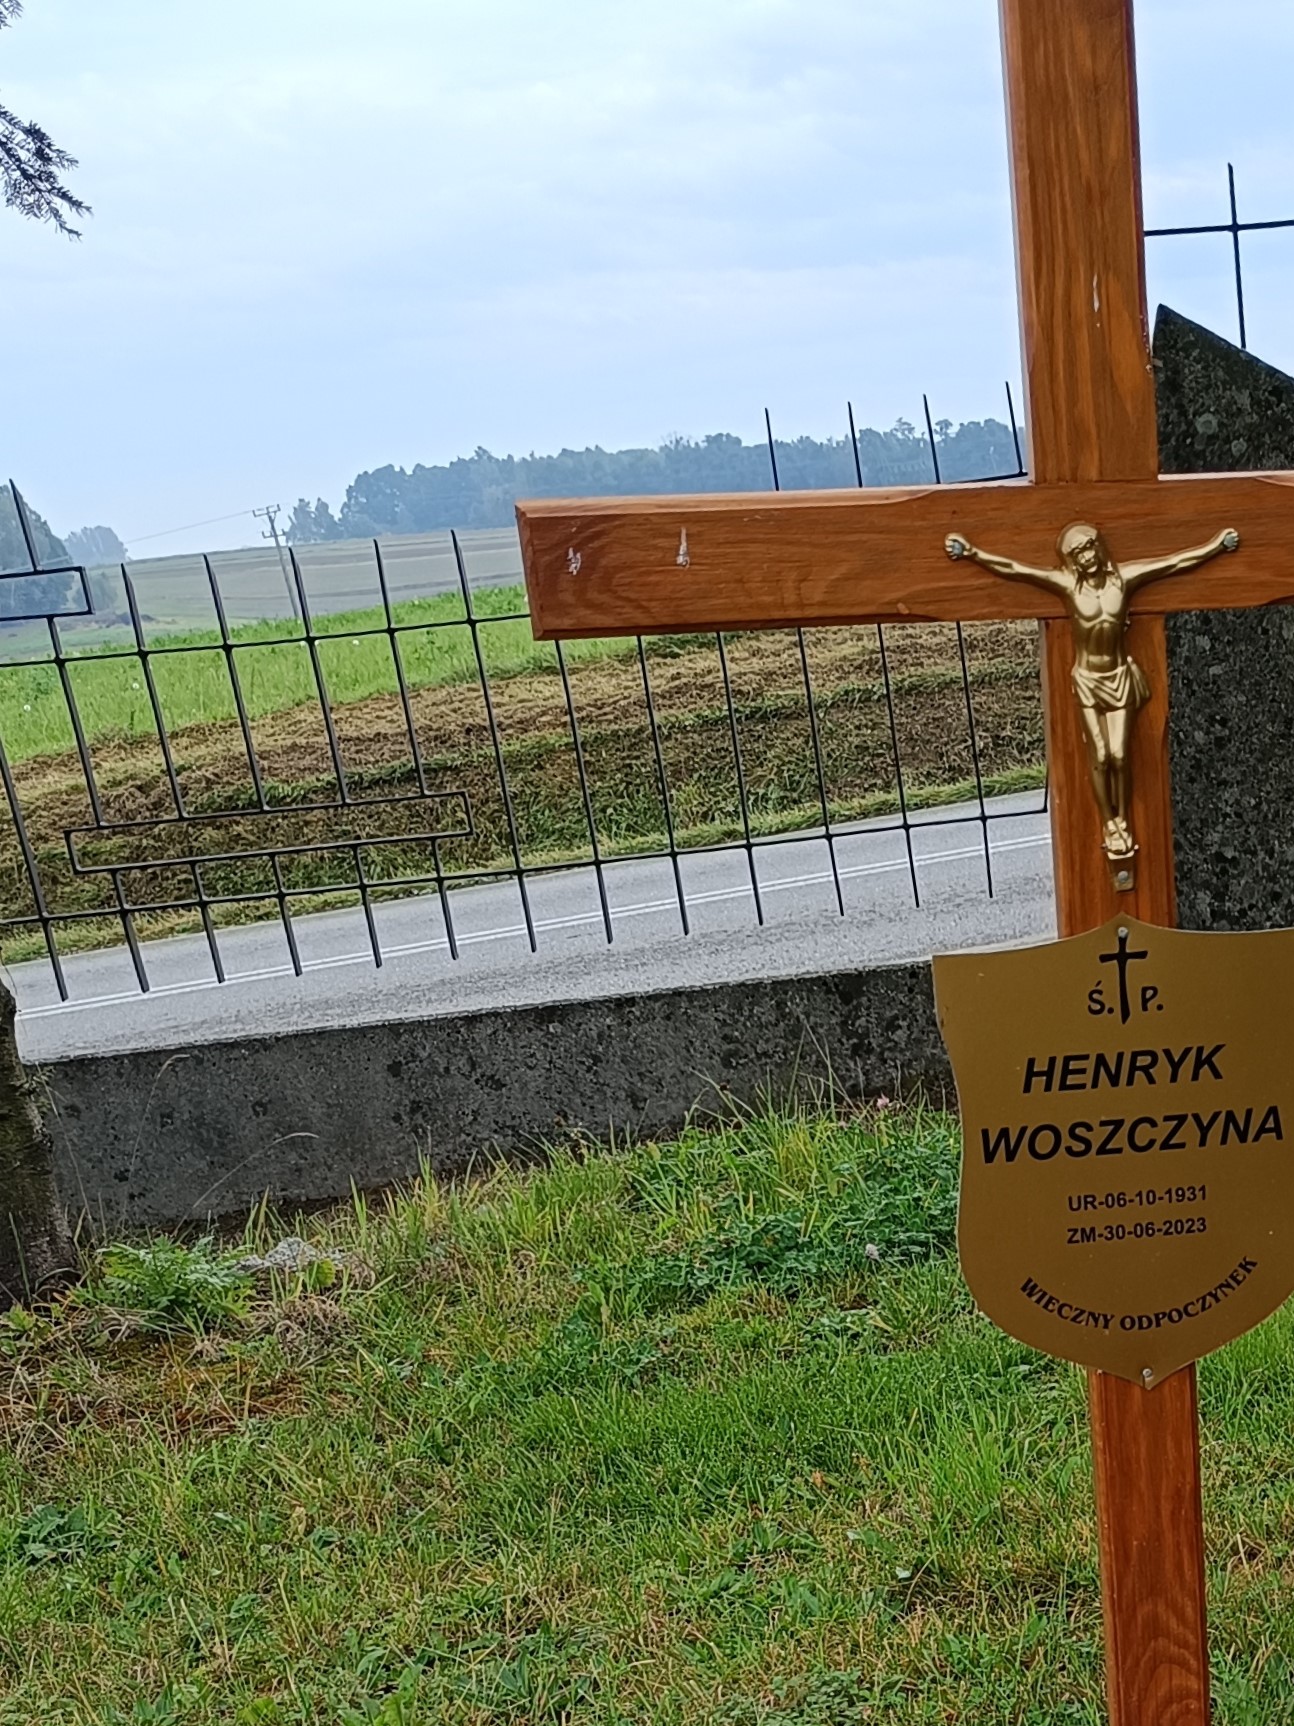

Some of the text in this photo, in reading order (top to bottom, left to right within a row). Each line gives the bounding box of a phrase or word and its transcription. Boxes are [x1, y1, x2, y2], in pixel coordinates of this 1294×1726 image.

[1141, 986, 1164, 1012] P.
[1022, 1043, 1226, 1094] HENRYK
[980, 1105, 1284, 1164] WOSZCZYNA
[1067, 1185, 1207, 1212] UR-06-10-1931
[1066, 1217, 1207, 1245] ZM-30-06-2023
[1020, 1255, 1258, 1331] WIECZNY ODPOCZYNEK
